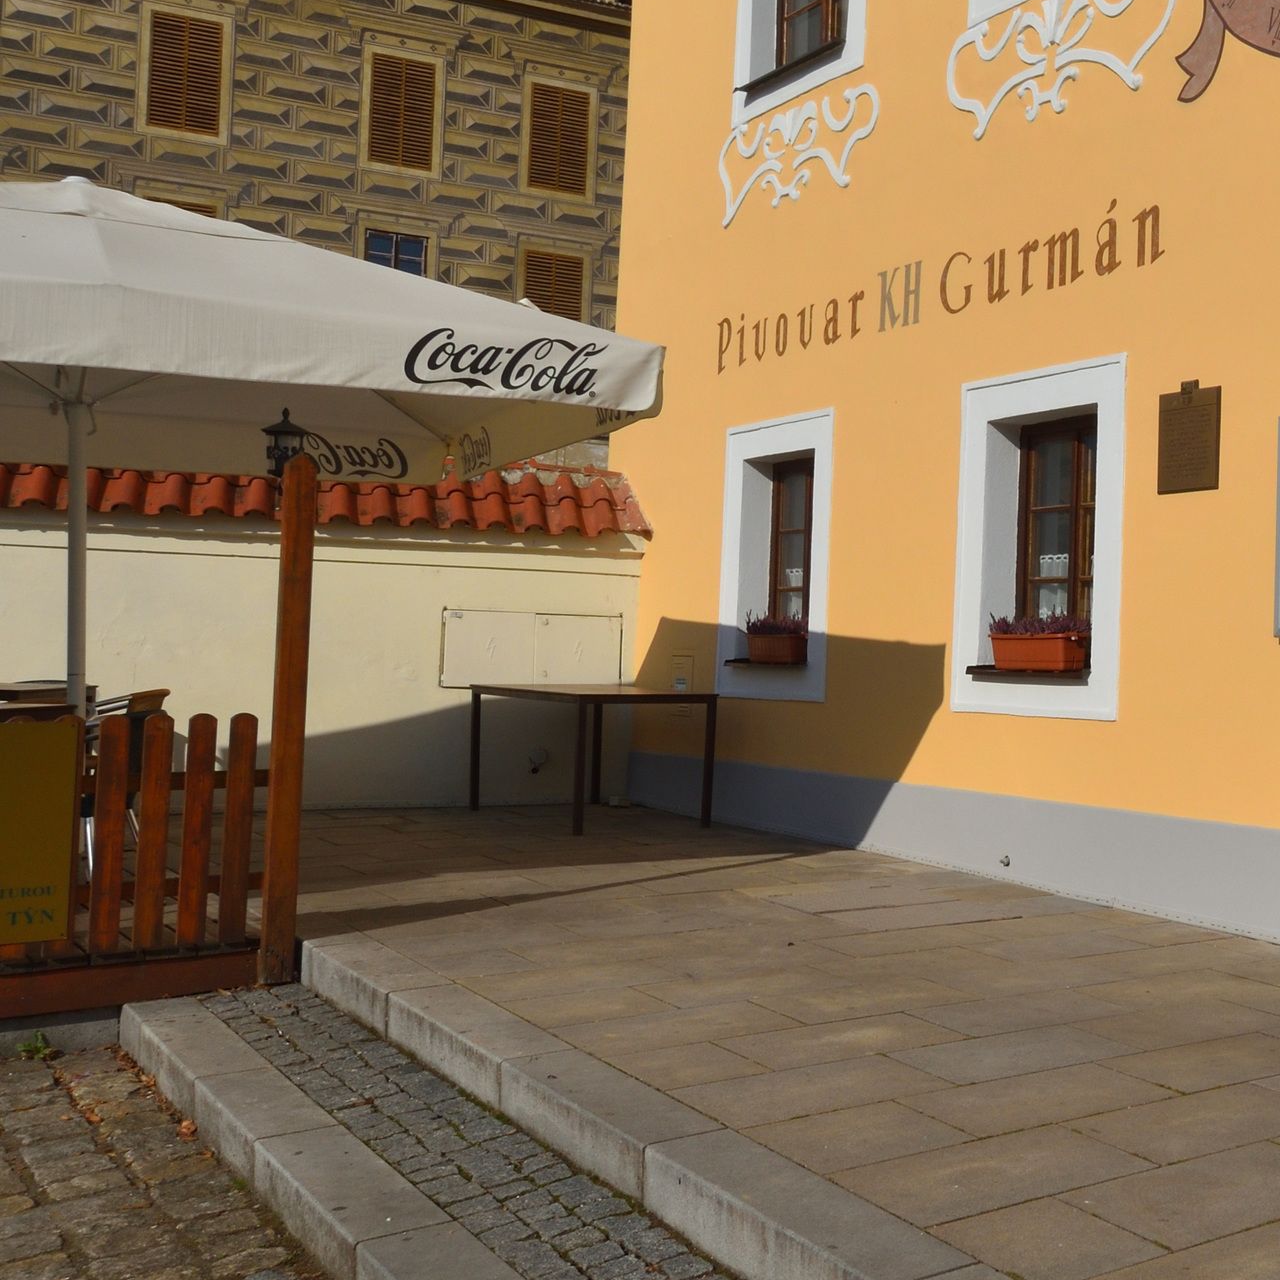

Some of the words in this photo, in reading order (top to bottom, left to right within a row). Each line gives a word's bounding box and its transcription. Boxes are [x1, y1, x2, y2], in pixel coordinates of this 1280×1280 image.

[716, 287, 865, 376] Pivovar
[876, 258, 924, 334] KH
[938, 197, 1166, 315] Gurmán
[403, 326, 609, 398] Coca-Cola
